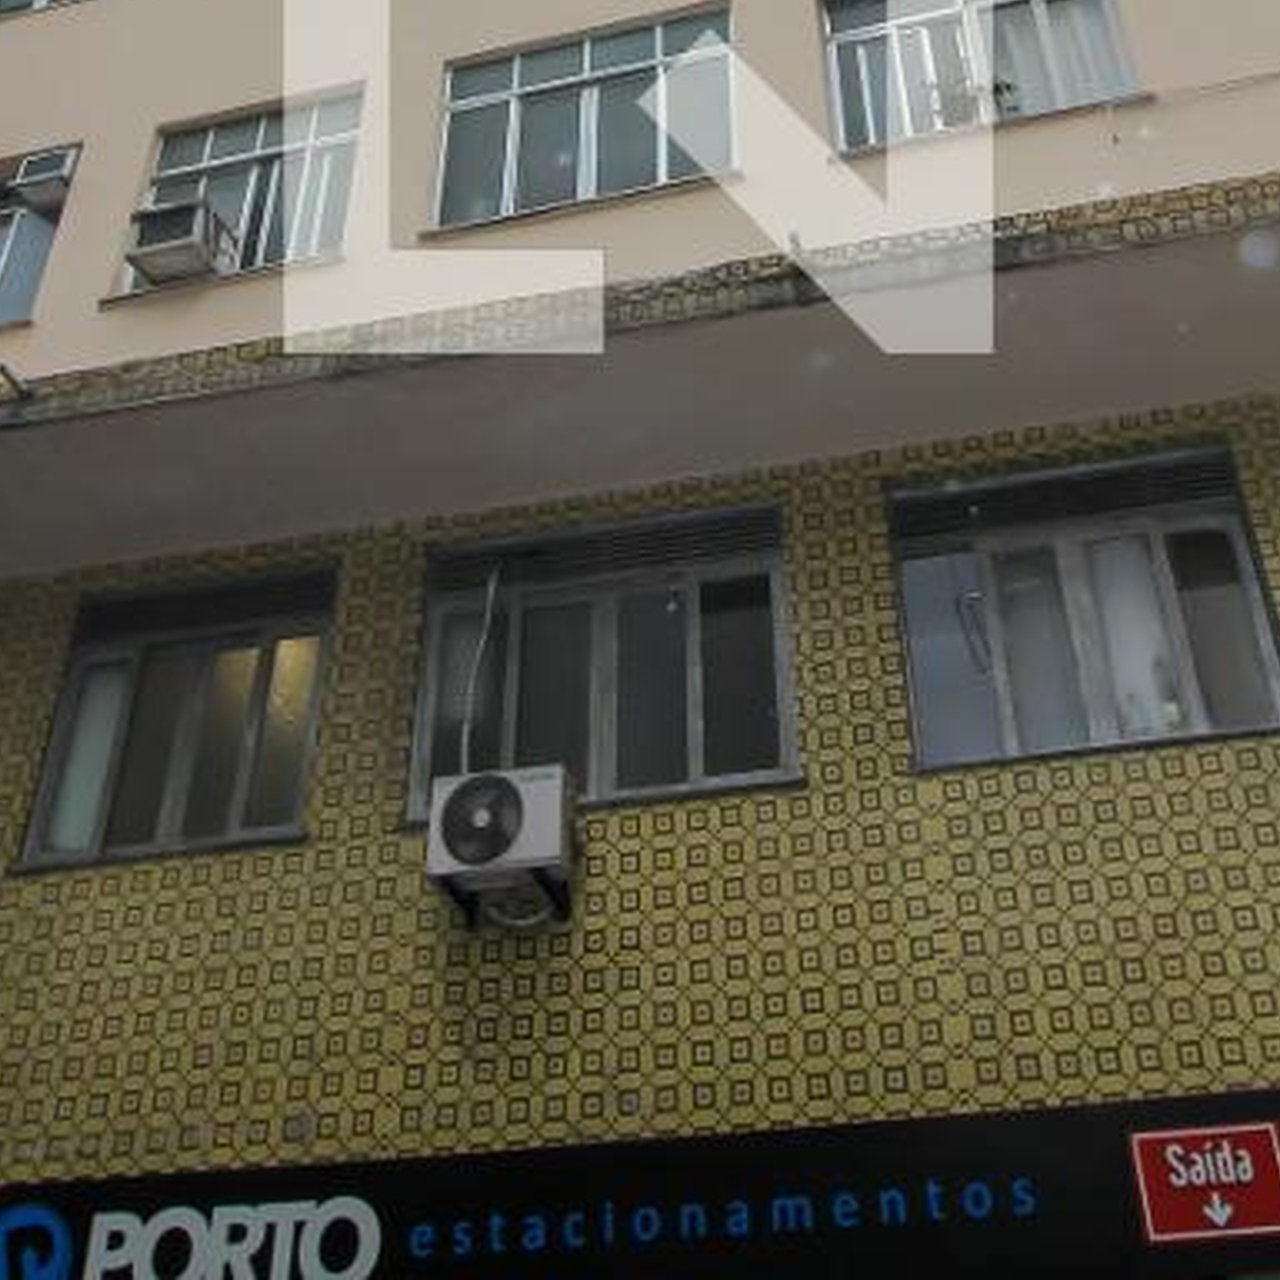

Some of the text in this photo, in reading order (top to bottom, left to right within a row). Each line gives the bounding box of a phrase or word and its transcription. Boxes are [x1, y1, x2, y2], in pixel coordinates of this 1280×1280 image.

[1166, 1141, 1255, 1187] Saída
[82, 1177, 1038, 1280] PORTO estacionamentos
